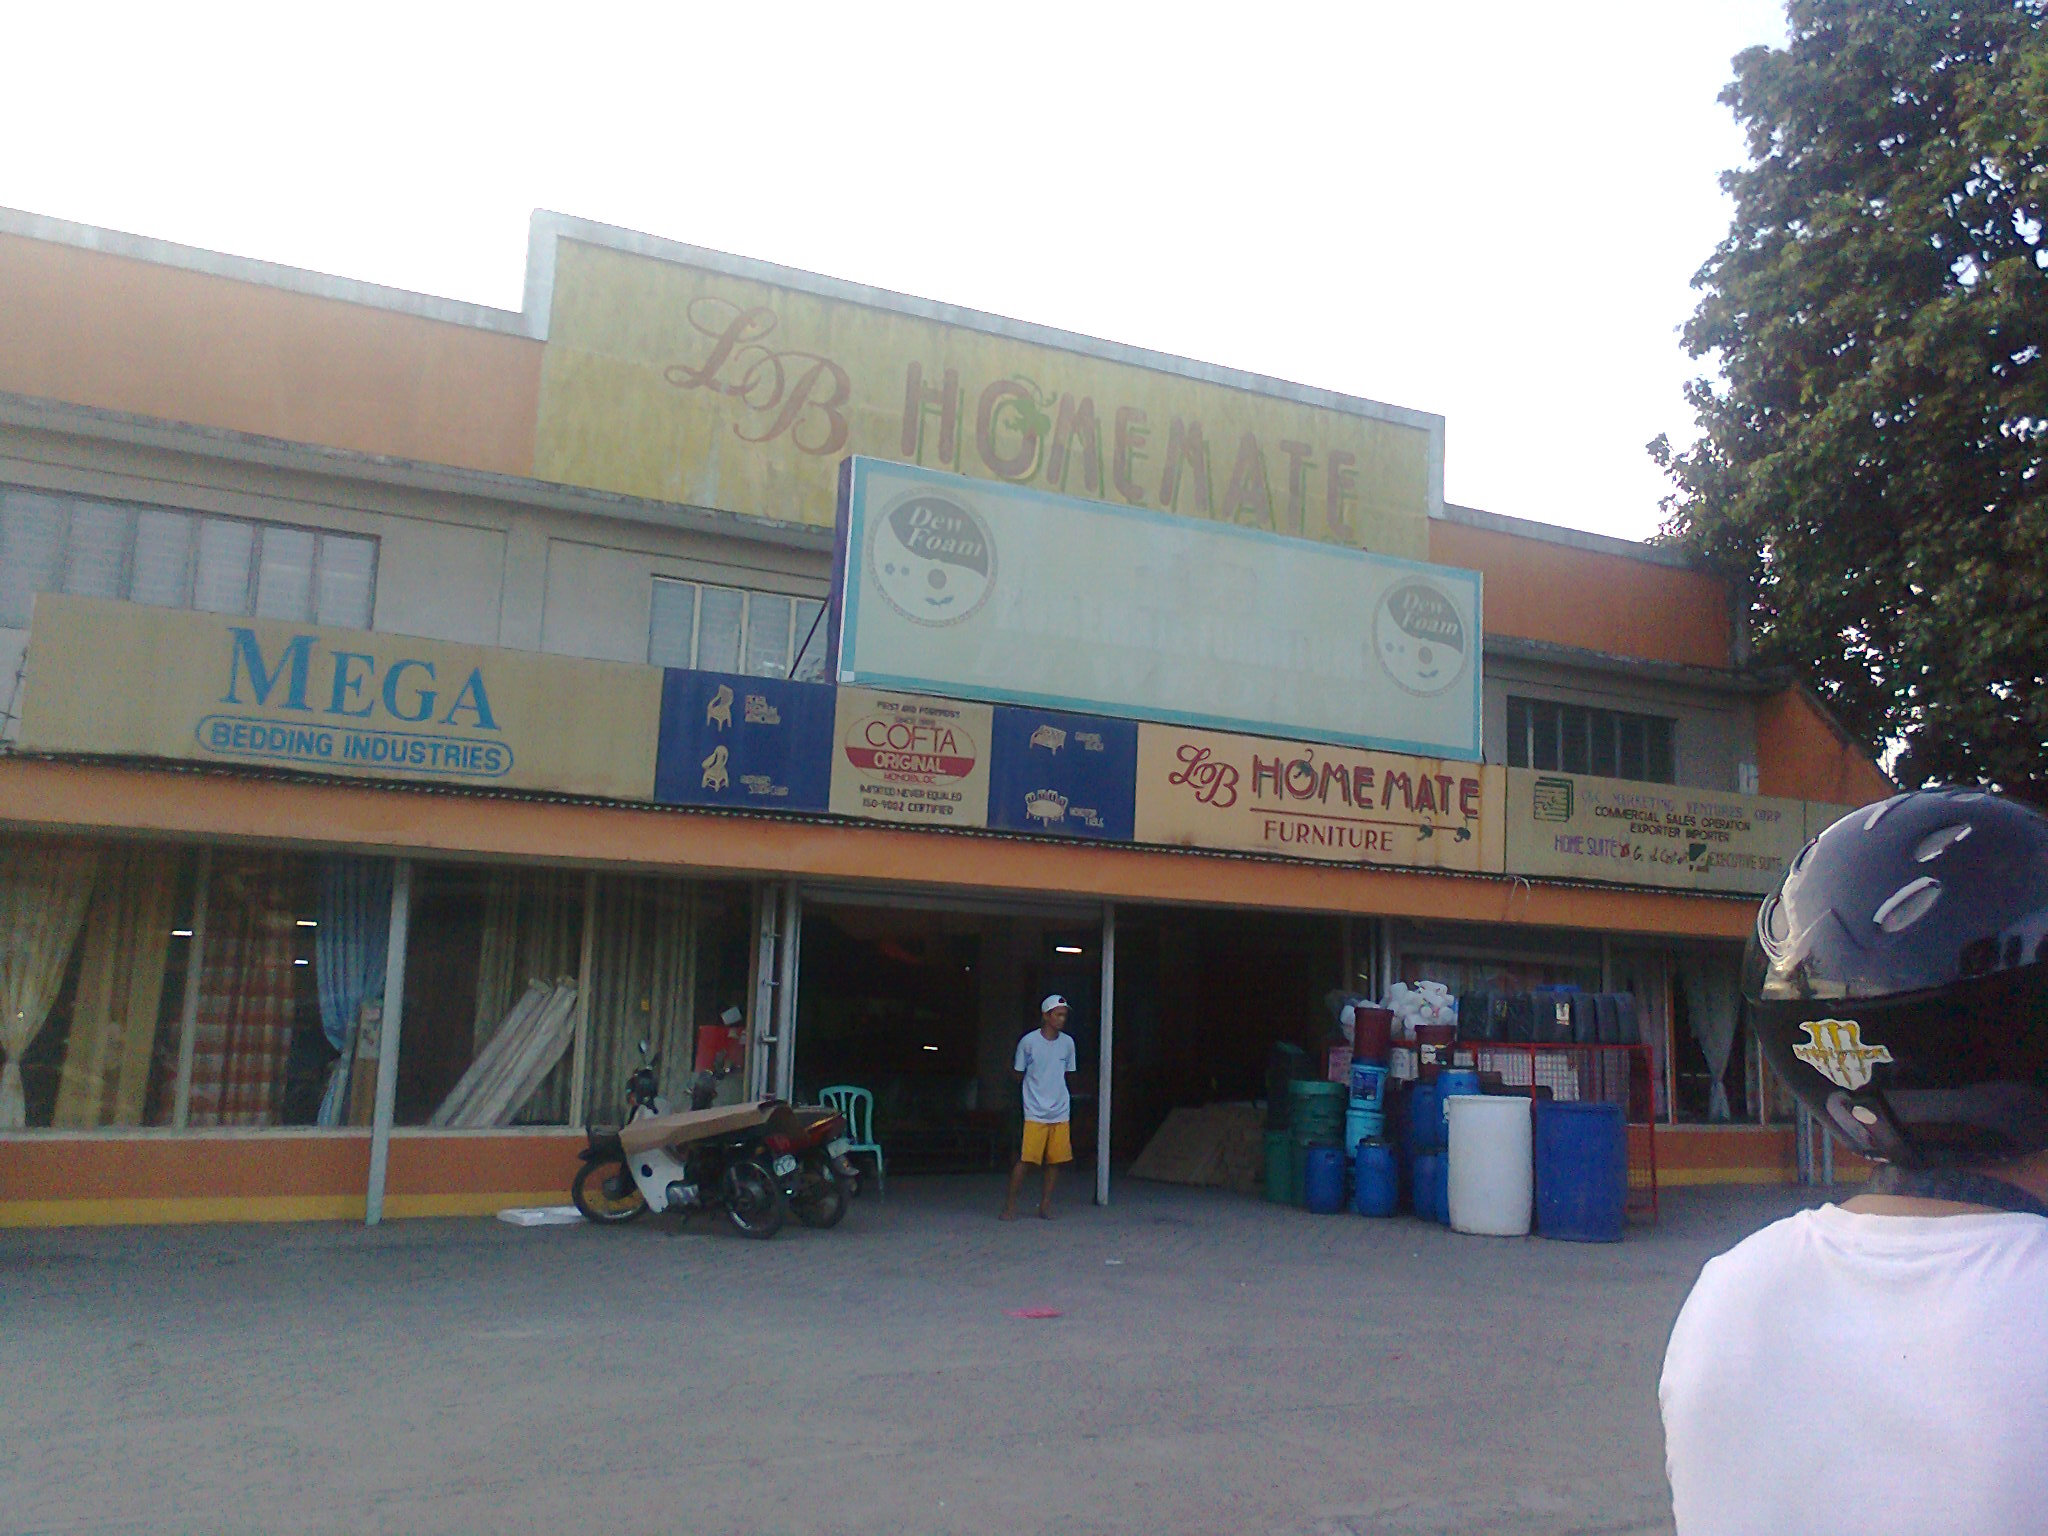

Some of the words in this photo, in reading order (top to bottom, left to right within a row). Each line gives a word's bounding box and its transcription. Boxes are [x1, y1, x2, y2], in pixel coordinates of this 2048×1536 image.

[900, 360, 1360, 547] HOMEMATE
[908, 526, 982, 557] Foam
[218, 626, 503, 731] MEGA
[210, 721, 333, 758] BEDDING
[343, 734, 502, 773] INDUSTRIES
[865, 720, 957, 755] COFTA
[873, 751, 946, 774] ORIGINAL
[1251, 748, 1481, 820] HOMEMATE
[907, 802, 954, 815] CERTIFIED
[1595, 806, 1659, 823] COMMERCIAL
[1666, 813, 1696, 827] SALES
[1701, 817, 1751, 832] OPERATION
[1263, 820, 1394, 852] FURNITURE
[1630, 821, 1681, 838] EXPORTER
